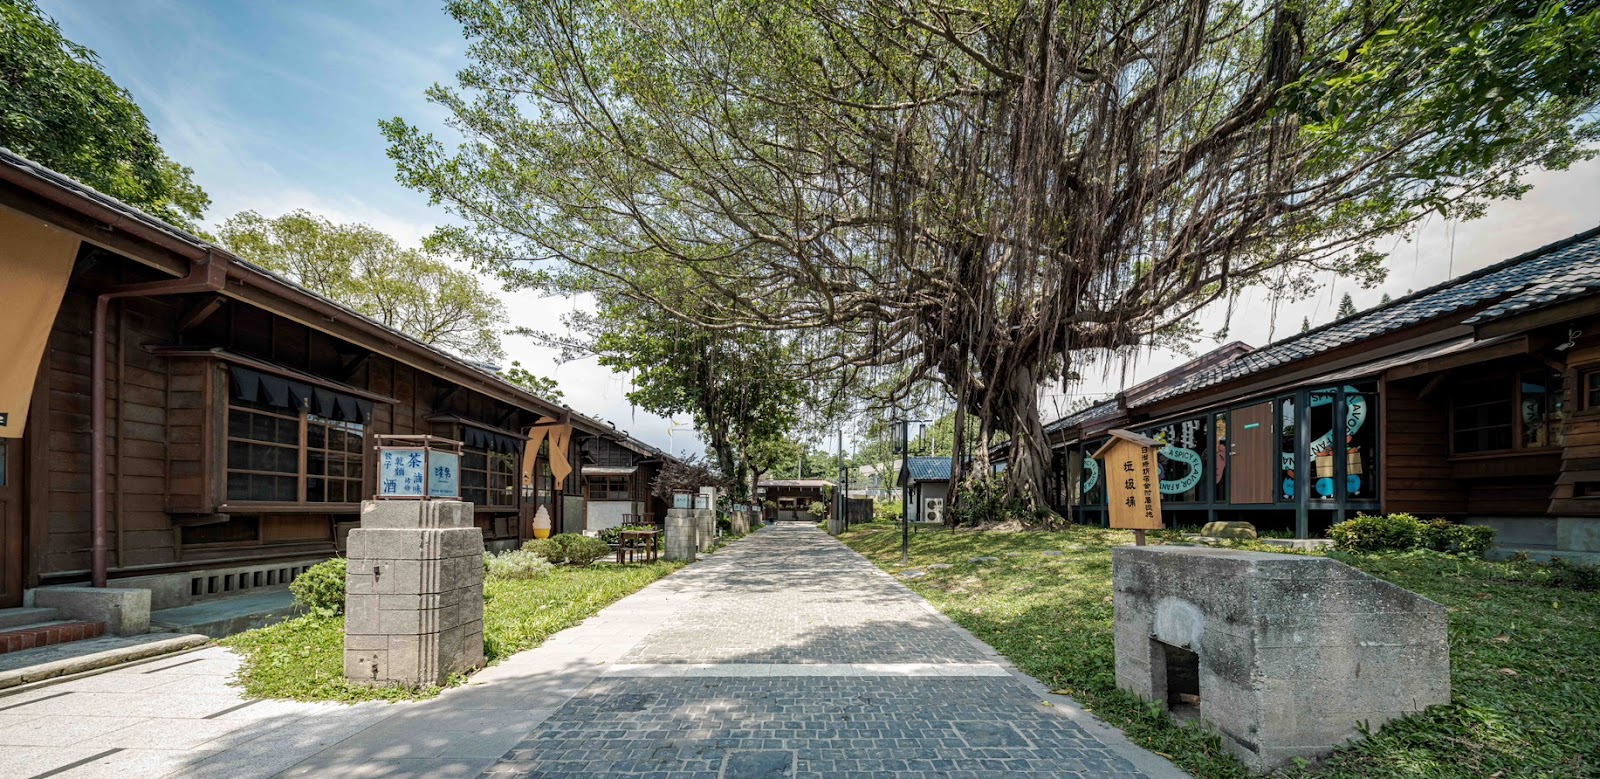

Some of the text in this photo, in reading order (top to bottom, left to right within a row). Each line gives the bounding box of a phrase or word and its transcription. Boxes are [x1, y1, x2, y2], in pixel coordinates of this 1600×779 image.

[384, 452, 392, 469] 餃子
[408, 453, 422, 468] 茶
[1175, 450, 1194, 460] SPICY
[383, 478, 397, 493] 酒
[412, 472, 423, 494] 滷味
[1123, 461, 1136, 508] 垃圾桶
